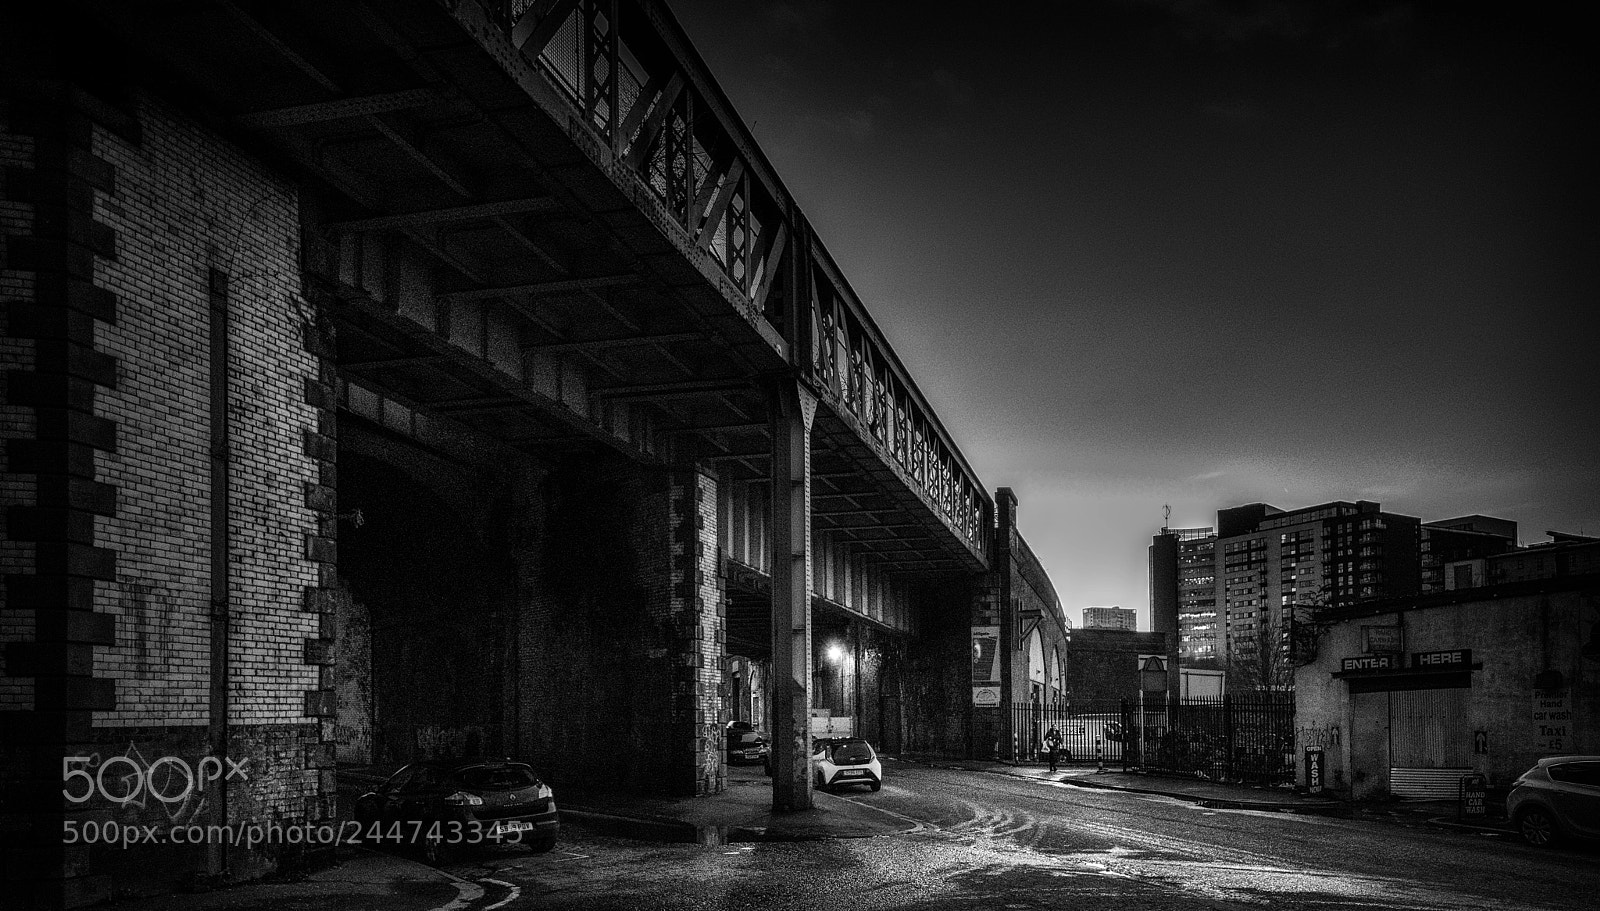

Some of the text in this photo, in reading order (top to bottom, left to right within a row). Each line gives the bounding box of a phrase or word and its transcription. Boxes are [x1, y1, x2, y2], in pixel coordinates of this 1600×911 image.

[1344, 651, 1462, 670] ENTER HERE
[1540, 699, 1563, 708] Hand
[1533, 709, 1572, 720] car wash
[1539, 725, 1566, 737] Taxi
[1549, 738, 1563, 750] £5
[1310, 753, 1319, 786] WASH
[1465, 791, 1486, 799] HAND
[1468, 798, 1483, 806] CAR
[1465, 806, 1486, 815] WASH
